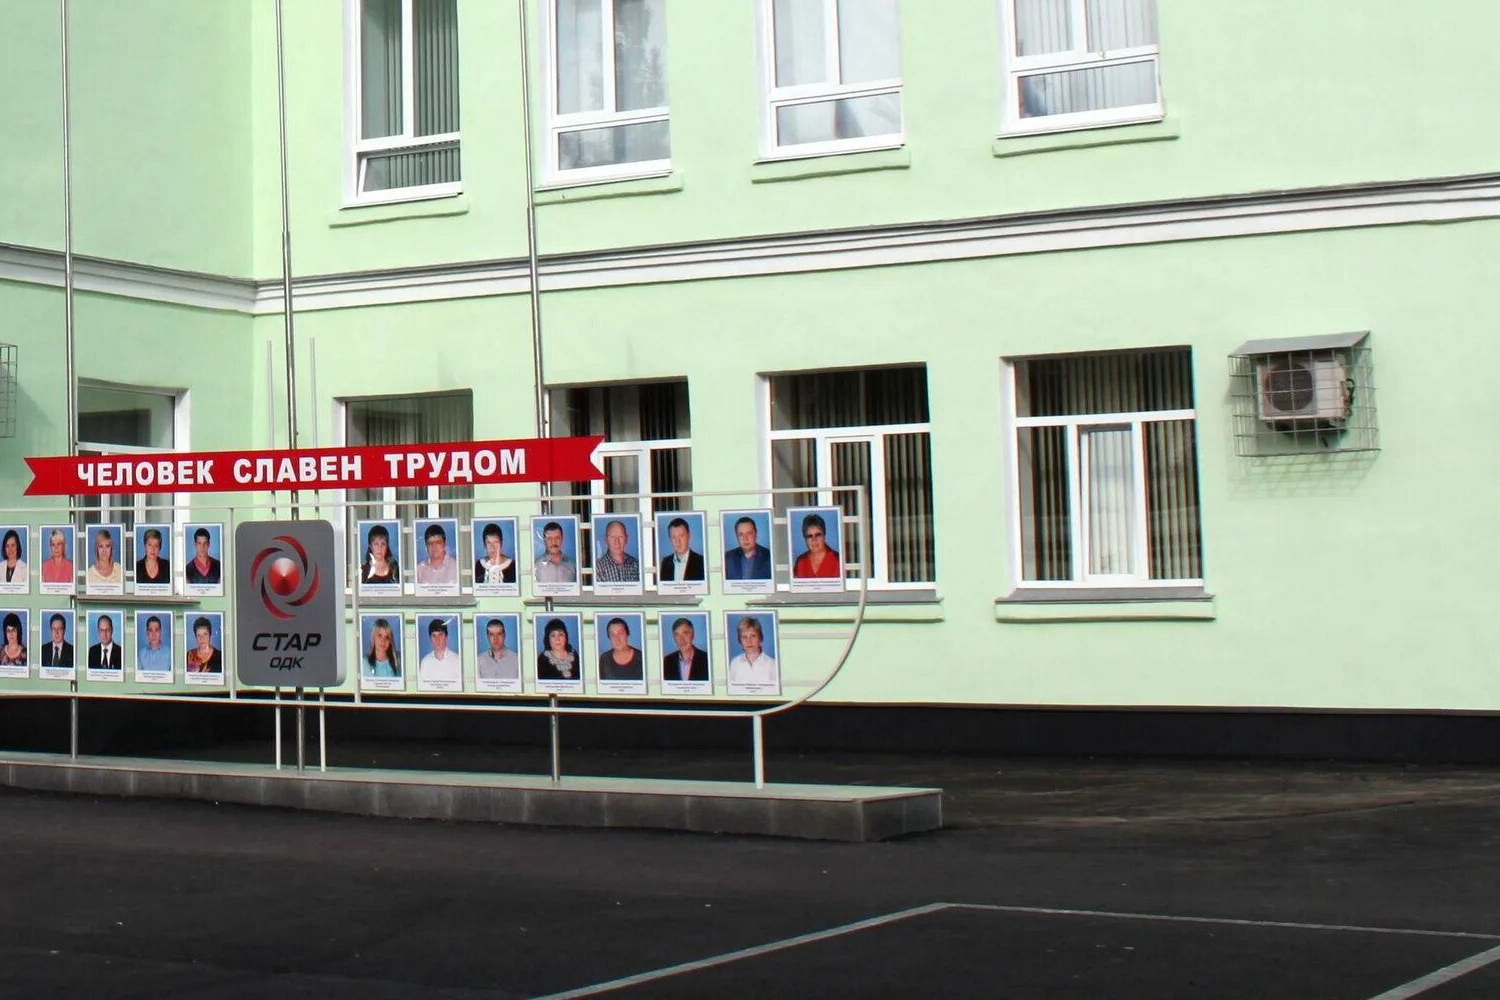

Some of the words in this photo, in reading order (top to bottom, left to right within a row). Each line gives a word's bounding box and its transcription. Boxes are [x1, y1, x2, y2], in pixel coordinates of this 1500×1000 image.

[77, 460, 215, 487] ЧЕЛОВЕК
[233, 455, 362, 484] СЛАВЕН
[384, 448, 526, 483] ТРУДОМ
[252, 633, 322, 651] СТАР
[269, 657, 304, 671] ОДК
